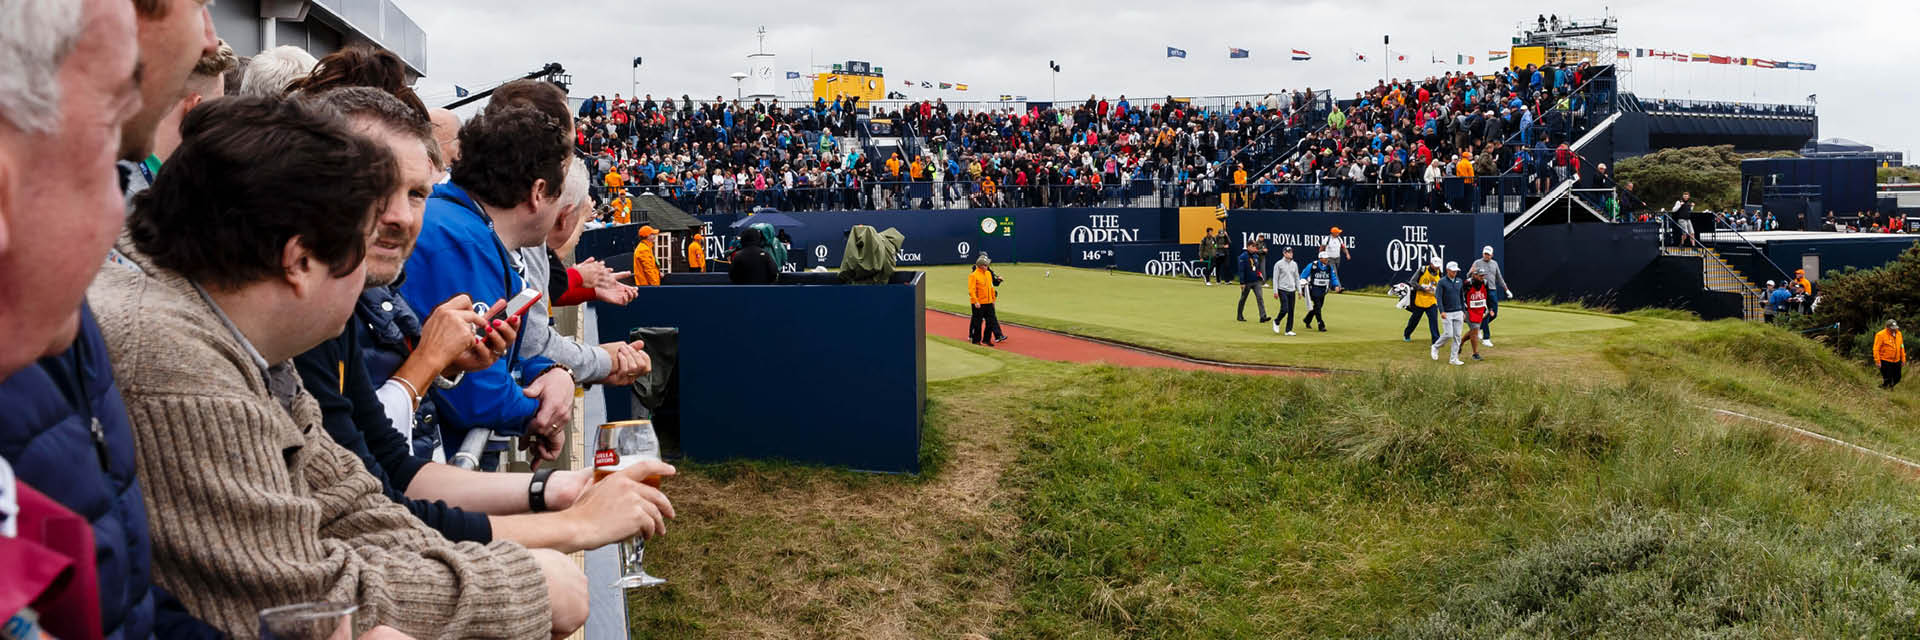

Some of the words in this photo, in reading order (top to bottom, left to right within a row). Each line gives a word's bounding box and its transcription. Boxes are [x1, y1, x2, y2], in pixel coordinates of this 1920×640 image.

[1089, 214, 1119, 228] THE
[1070, 225, 1139, 243] OPEN
[1272, 233, 1302, 246] ROYAL
[1304, 234, 1356, 249] BIRLE
[1402, 225, 1428, 243] THE
[1159, 251, 1181, 261] THE
[1386, 238, 1446, 273] OPEN
